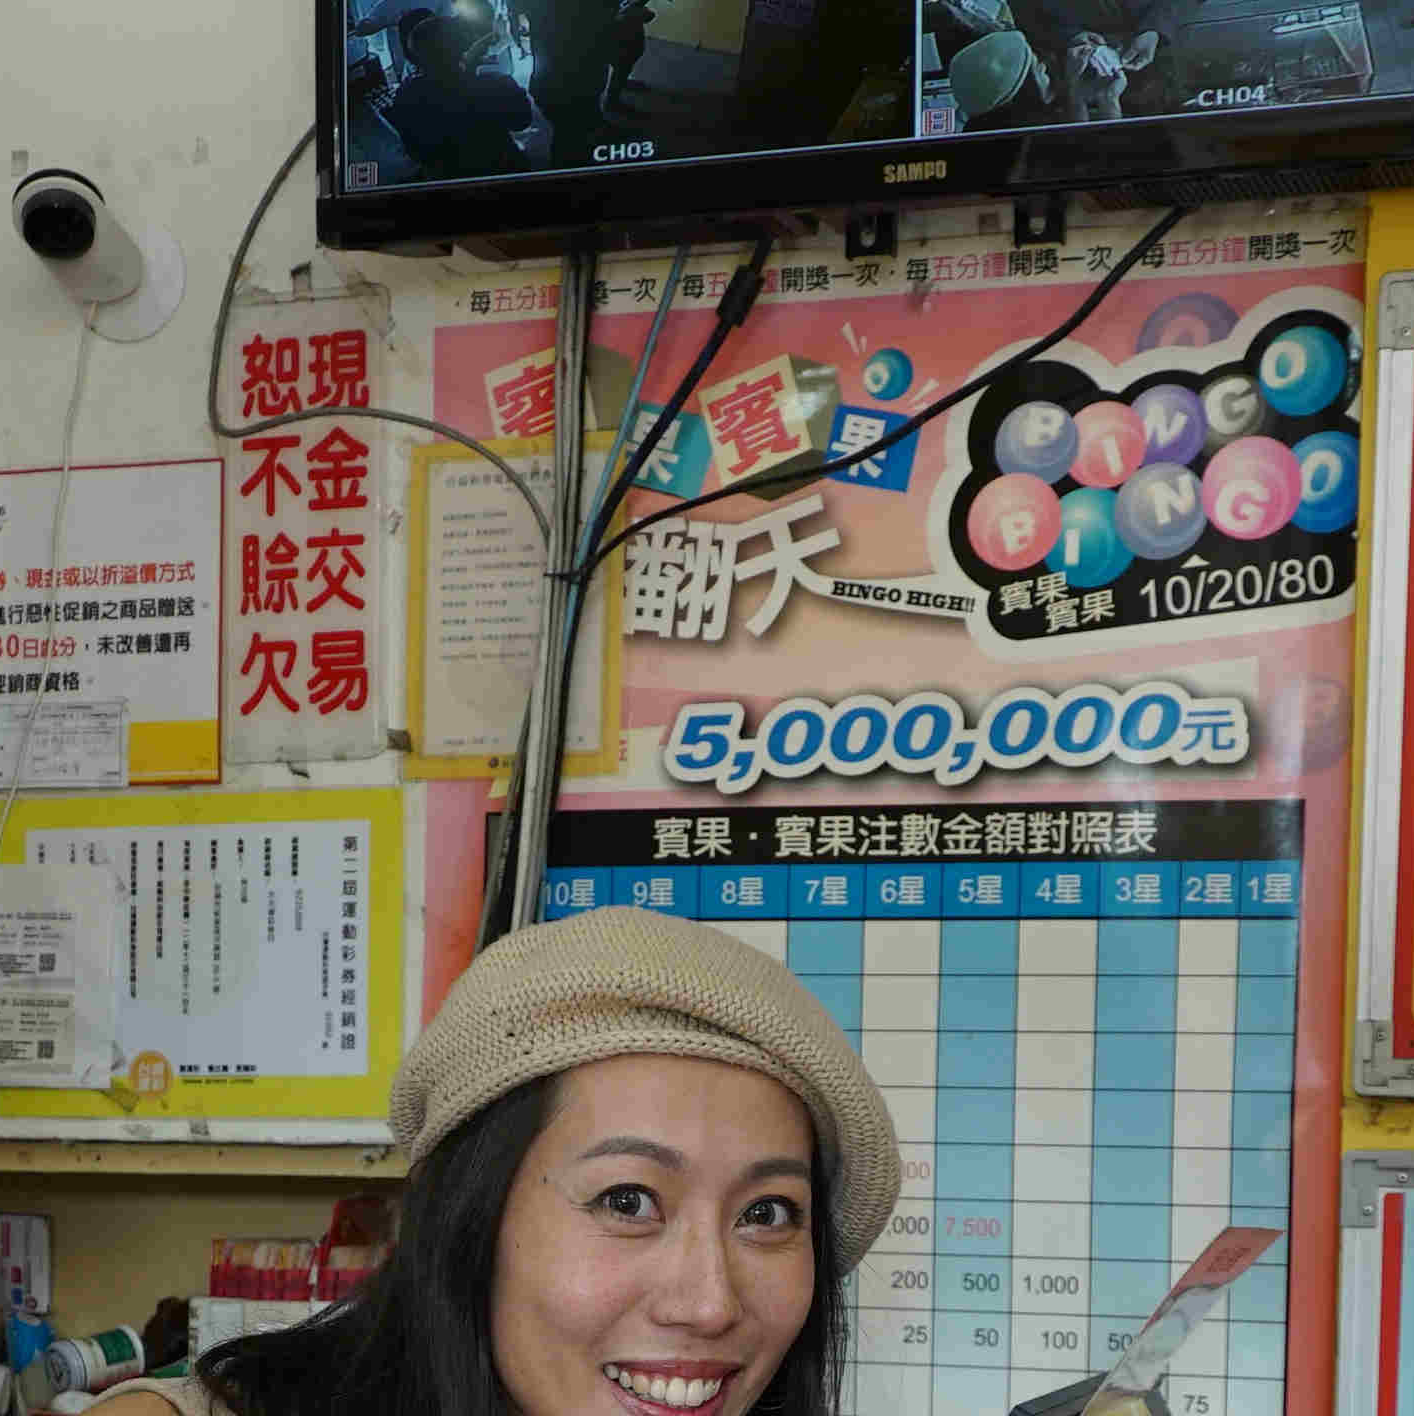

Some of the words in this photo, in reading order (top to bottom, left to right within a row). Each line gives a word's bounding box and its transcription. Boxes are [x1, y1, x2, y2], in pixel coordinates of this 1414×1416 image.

[1198, 86, 1267, 106] CH04
[593, 141, 655, 162] CH03
[883, 160, 947, 184] SAMPO
[240, 333, 302, 716] 恕不賒欠
[306, 330, 369, 715] 現金交易
[833, 581, 902, 603] BINGO
[999, 572, 1069, 616] 賓果
[1139, 554, 1335, 619] 10/20/80
[1045, 592, 1116, 634] 賓果
[674, 692, 1238, 782] 5,000,000元
[543, 878, 596, 907] 10星
[632, 878, 675, 907] 9星
[721, 877, 764, 907] 8星
[804, 876, 848, 905] 7星
[880, 876, 925, 905] 6星
[958, 874, 1003, 904] 5星
[1035, 874, 1081, 904] 4星
[1115, 874, 1162, 904] 3星
[1185, 873, 1233, 904] 2星
[1246, 873, 1293, 903] 1星
[945, 1217, 1002, 1239] 7,500
[891, 1271, 929, 1289] 200
[963, 1273, 1001, 1292] 500
[1023, 1275, 1080, 1298] 1,000
[903, 1325, 928, 1344] 25
[973, 1328, 999, 1347] 50
[1042, 1331, 1079, 1351] 100
[1182, 1395, 1210, 1415] 75
